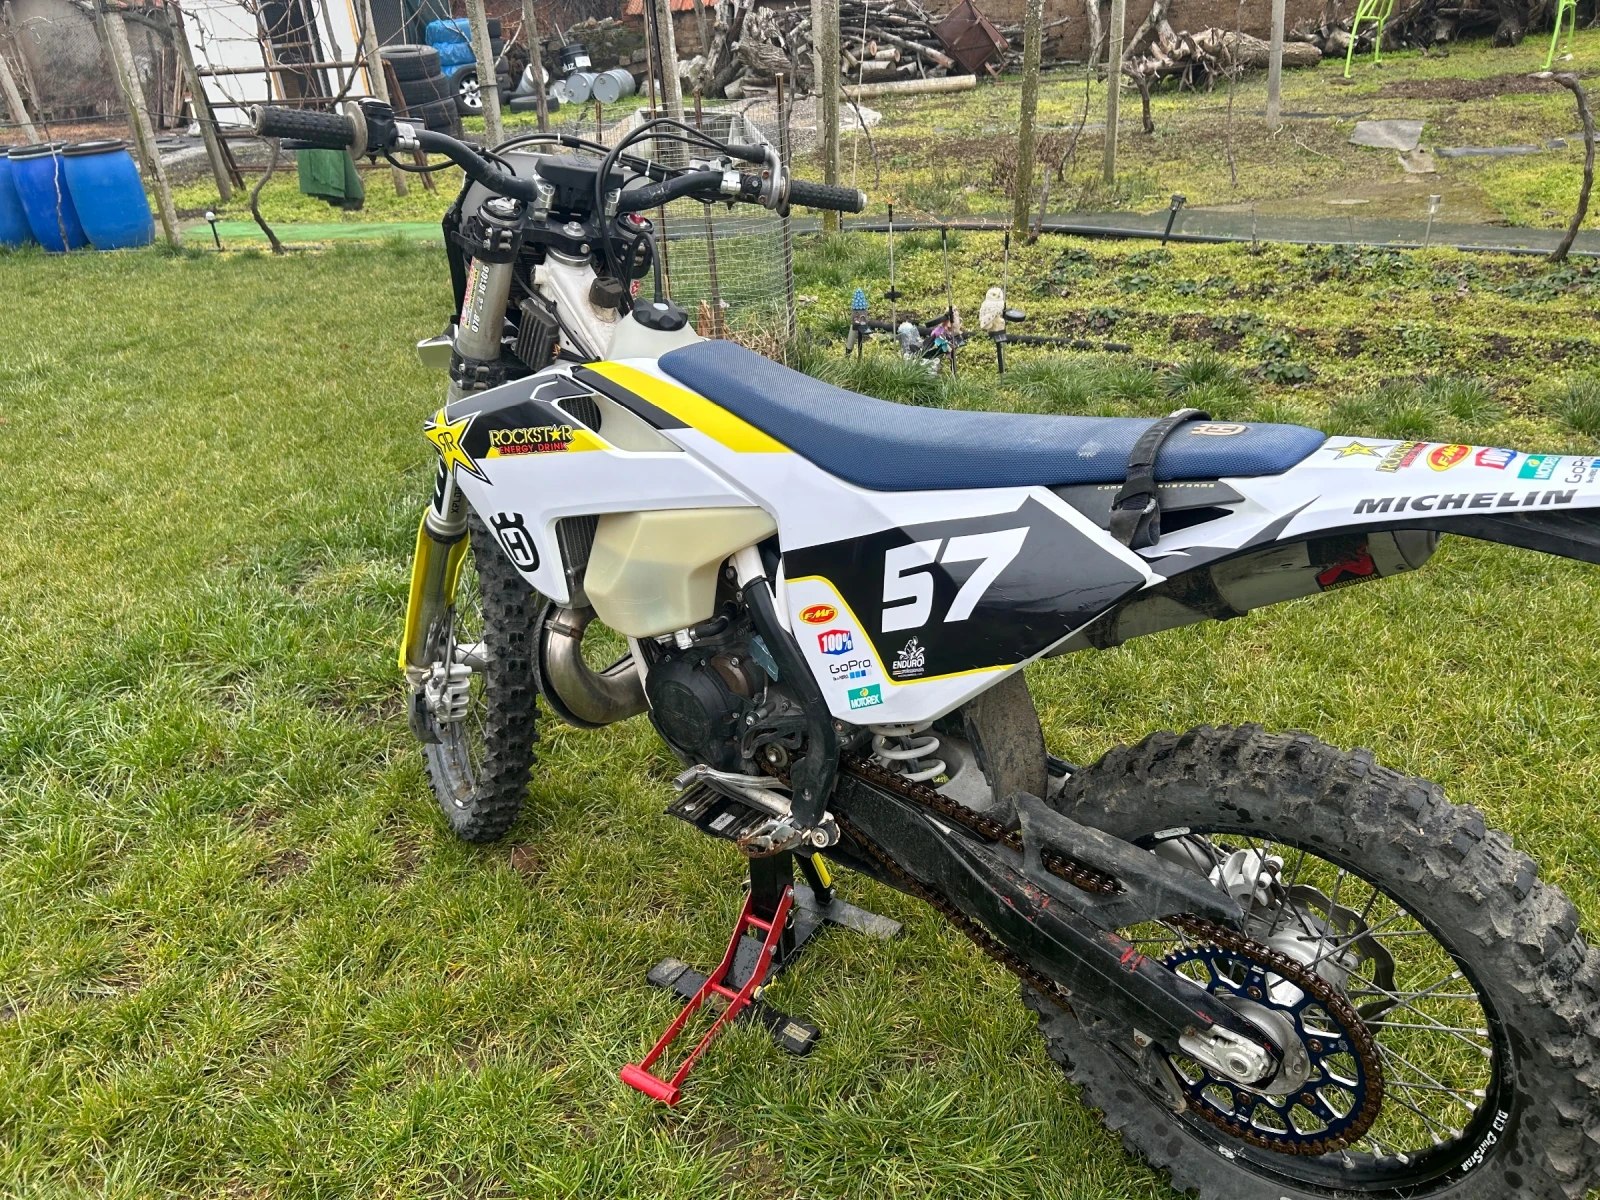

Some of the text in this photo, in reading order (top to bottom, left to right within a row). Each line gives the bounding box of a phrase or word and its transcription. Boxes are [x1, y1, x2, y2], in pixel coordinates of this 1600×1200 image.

[498, 442, 567, 455] ENERGY DRINK
[1353, 489, 1578, 515] MICHELIN
[882, 526, 1030, 633] 57
[802, 609, 835, 620] FMF
[821, 633, 852, 653] 100%
[829, 659, 871, 674] GoPro
[892, 659, 923, 670] ENDURO
[850, 694, 880, 709] MOTOREX
